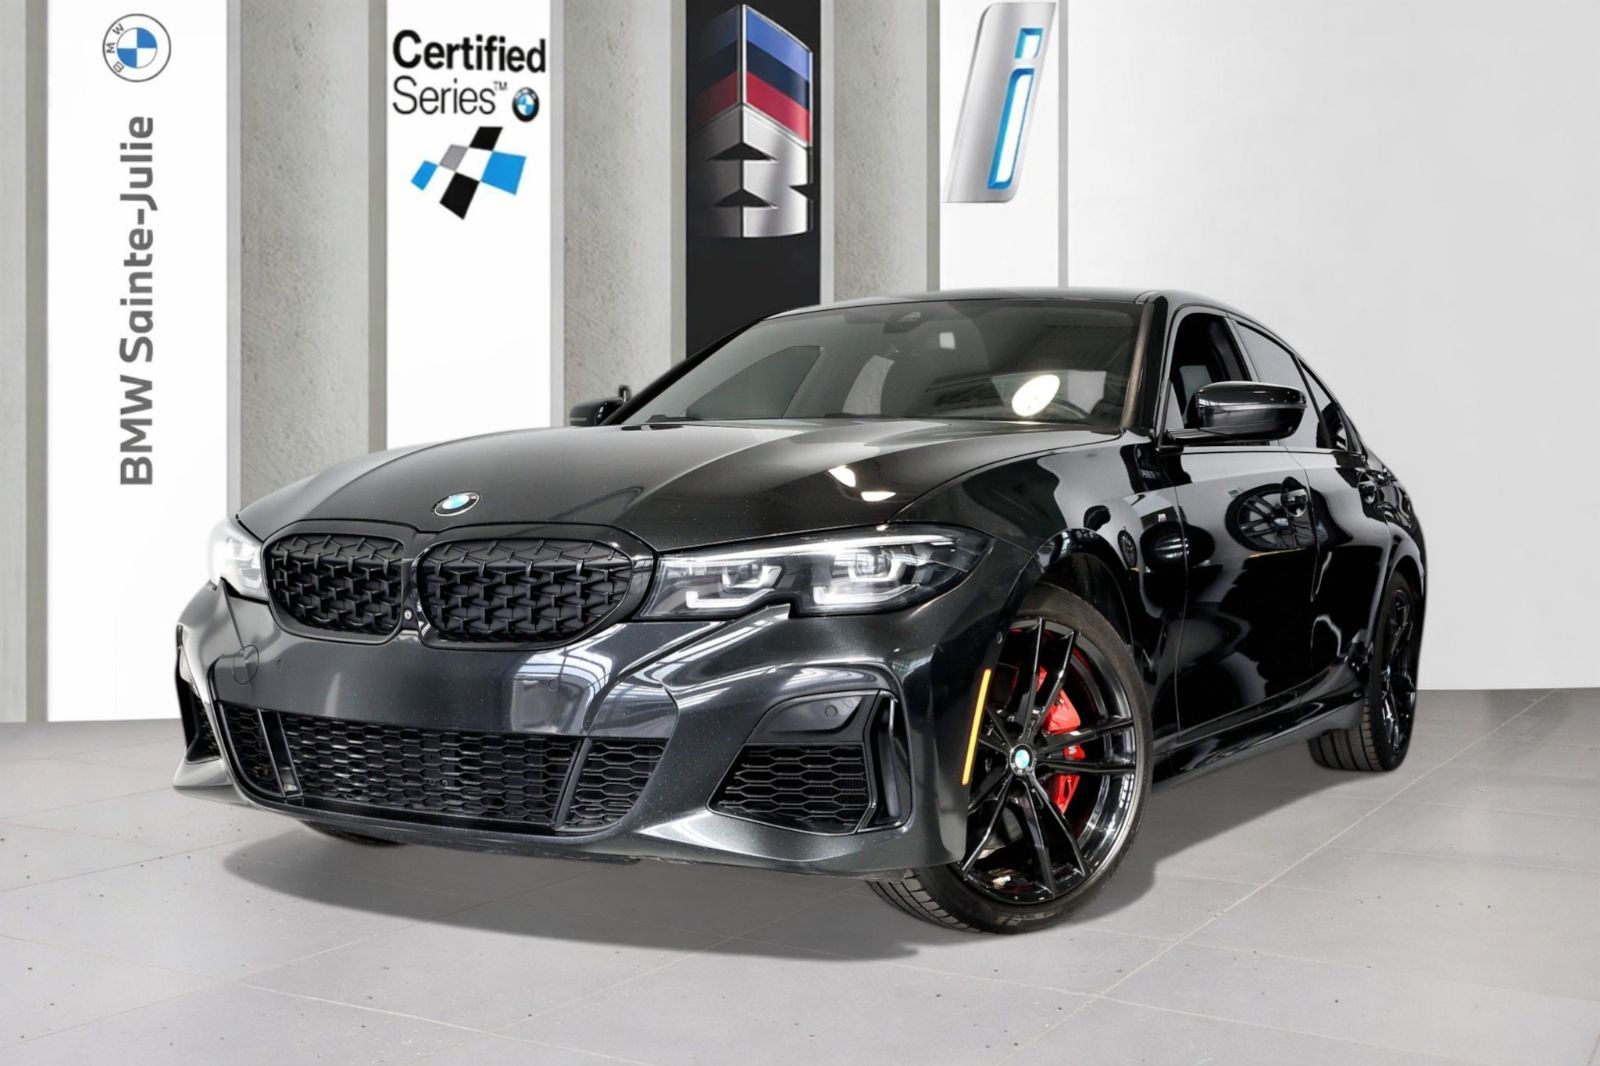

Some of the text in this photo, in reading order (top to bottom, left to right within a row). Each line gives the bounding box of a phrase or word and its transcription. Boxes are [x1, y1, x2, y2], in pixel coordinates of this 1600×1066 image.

[392, 29, 546, 74] Certified
[118, 116, 158, 485] BMW Sainte-Julie
